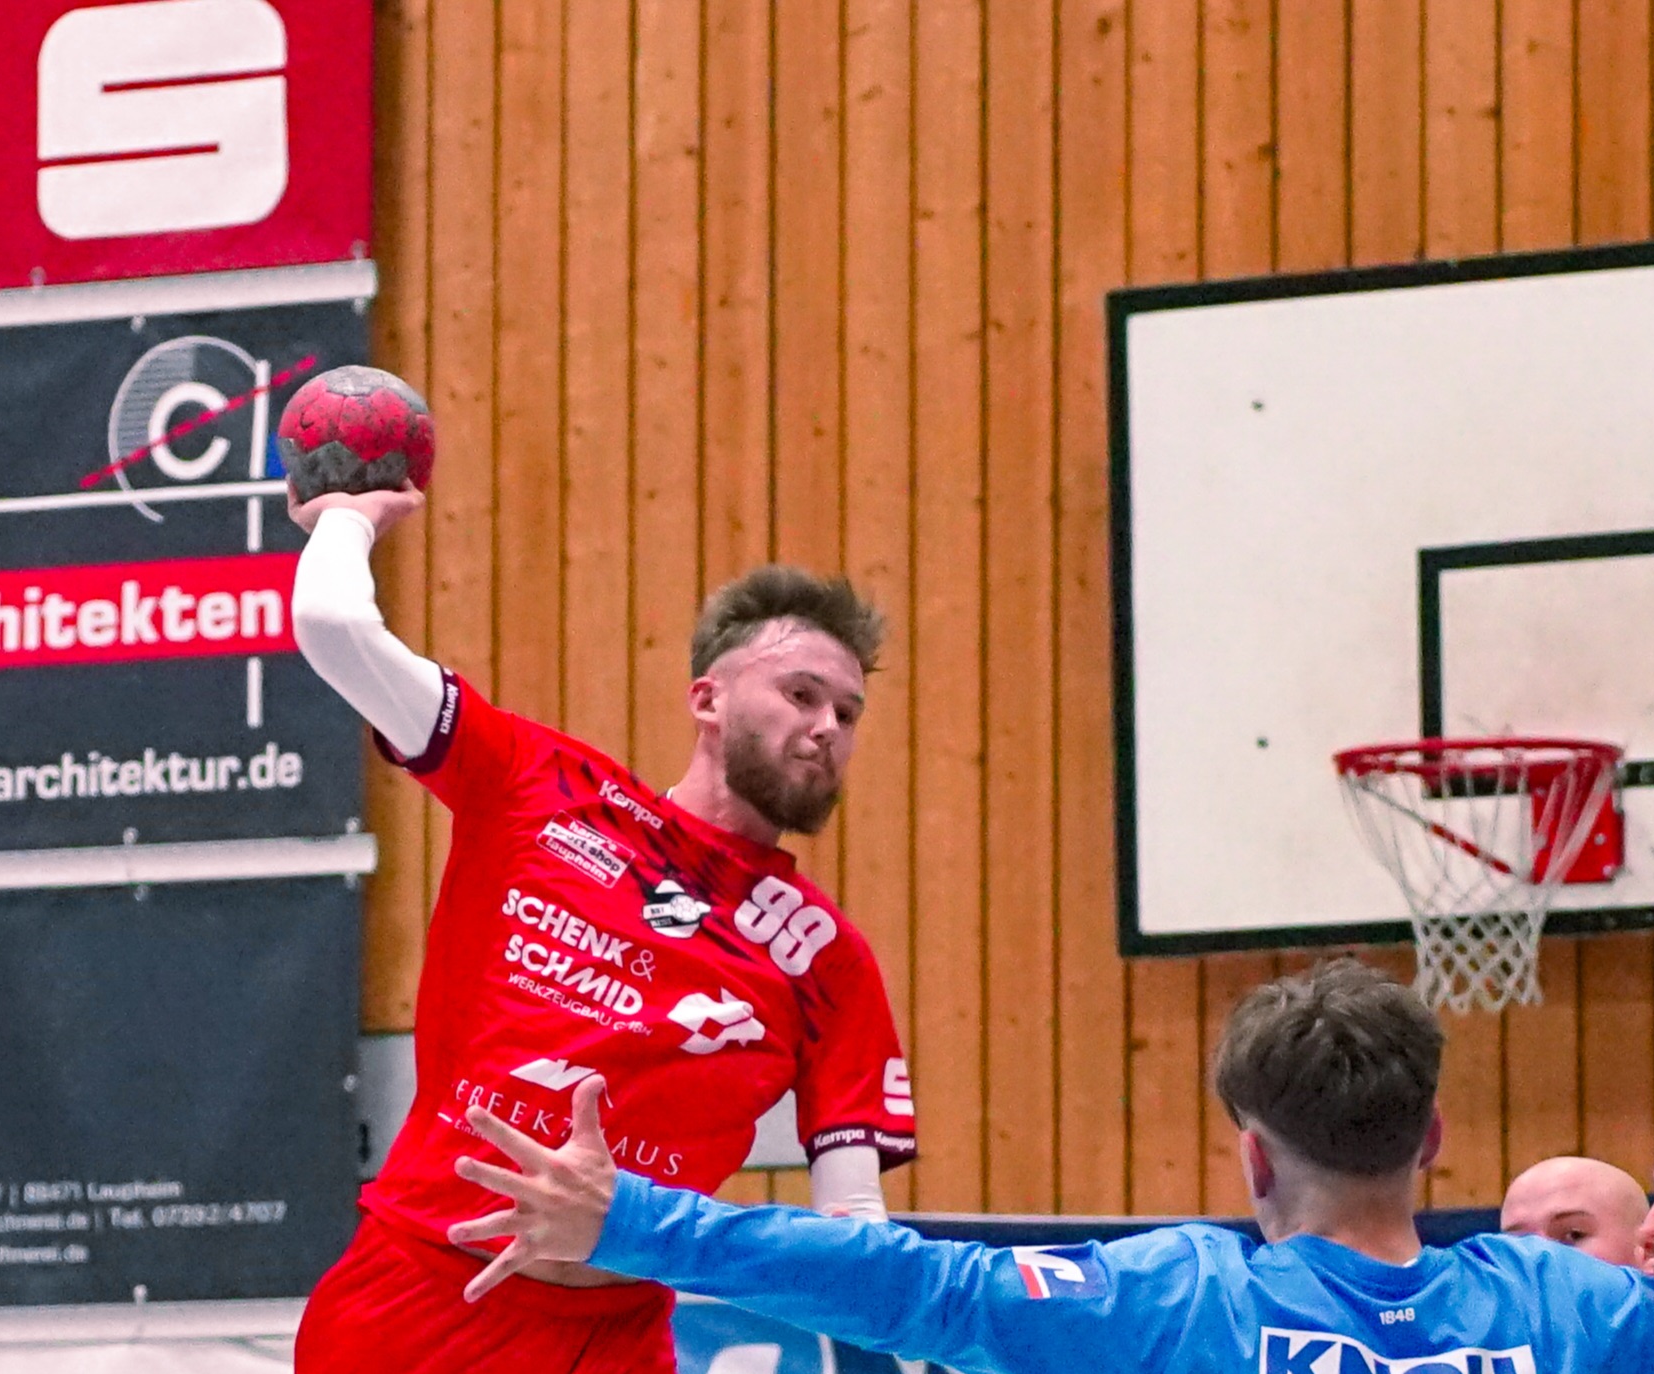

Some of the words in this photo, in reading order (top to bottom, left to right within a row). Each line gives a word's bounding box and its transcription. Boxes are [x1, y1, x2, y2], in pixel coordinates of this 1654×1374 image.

[598, 779, 664, 831] Kempa
[544, 836, 609, 883] laupheim
[587, 842, 622, 874] shop
[502, 888, 634, 968] SCHENK
[630, 949, 656, 982] &
[733, 875, 837, 977] 99
[505, 934, 644, 1015] SCHMID
[507, 972, 612, 1027] WERKZEUGBAU
[813, 1128, 866, 1150] Kempa
[1379, 1307, 1415, 1325] 1848
